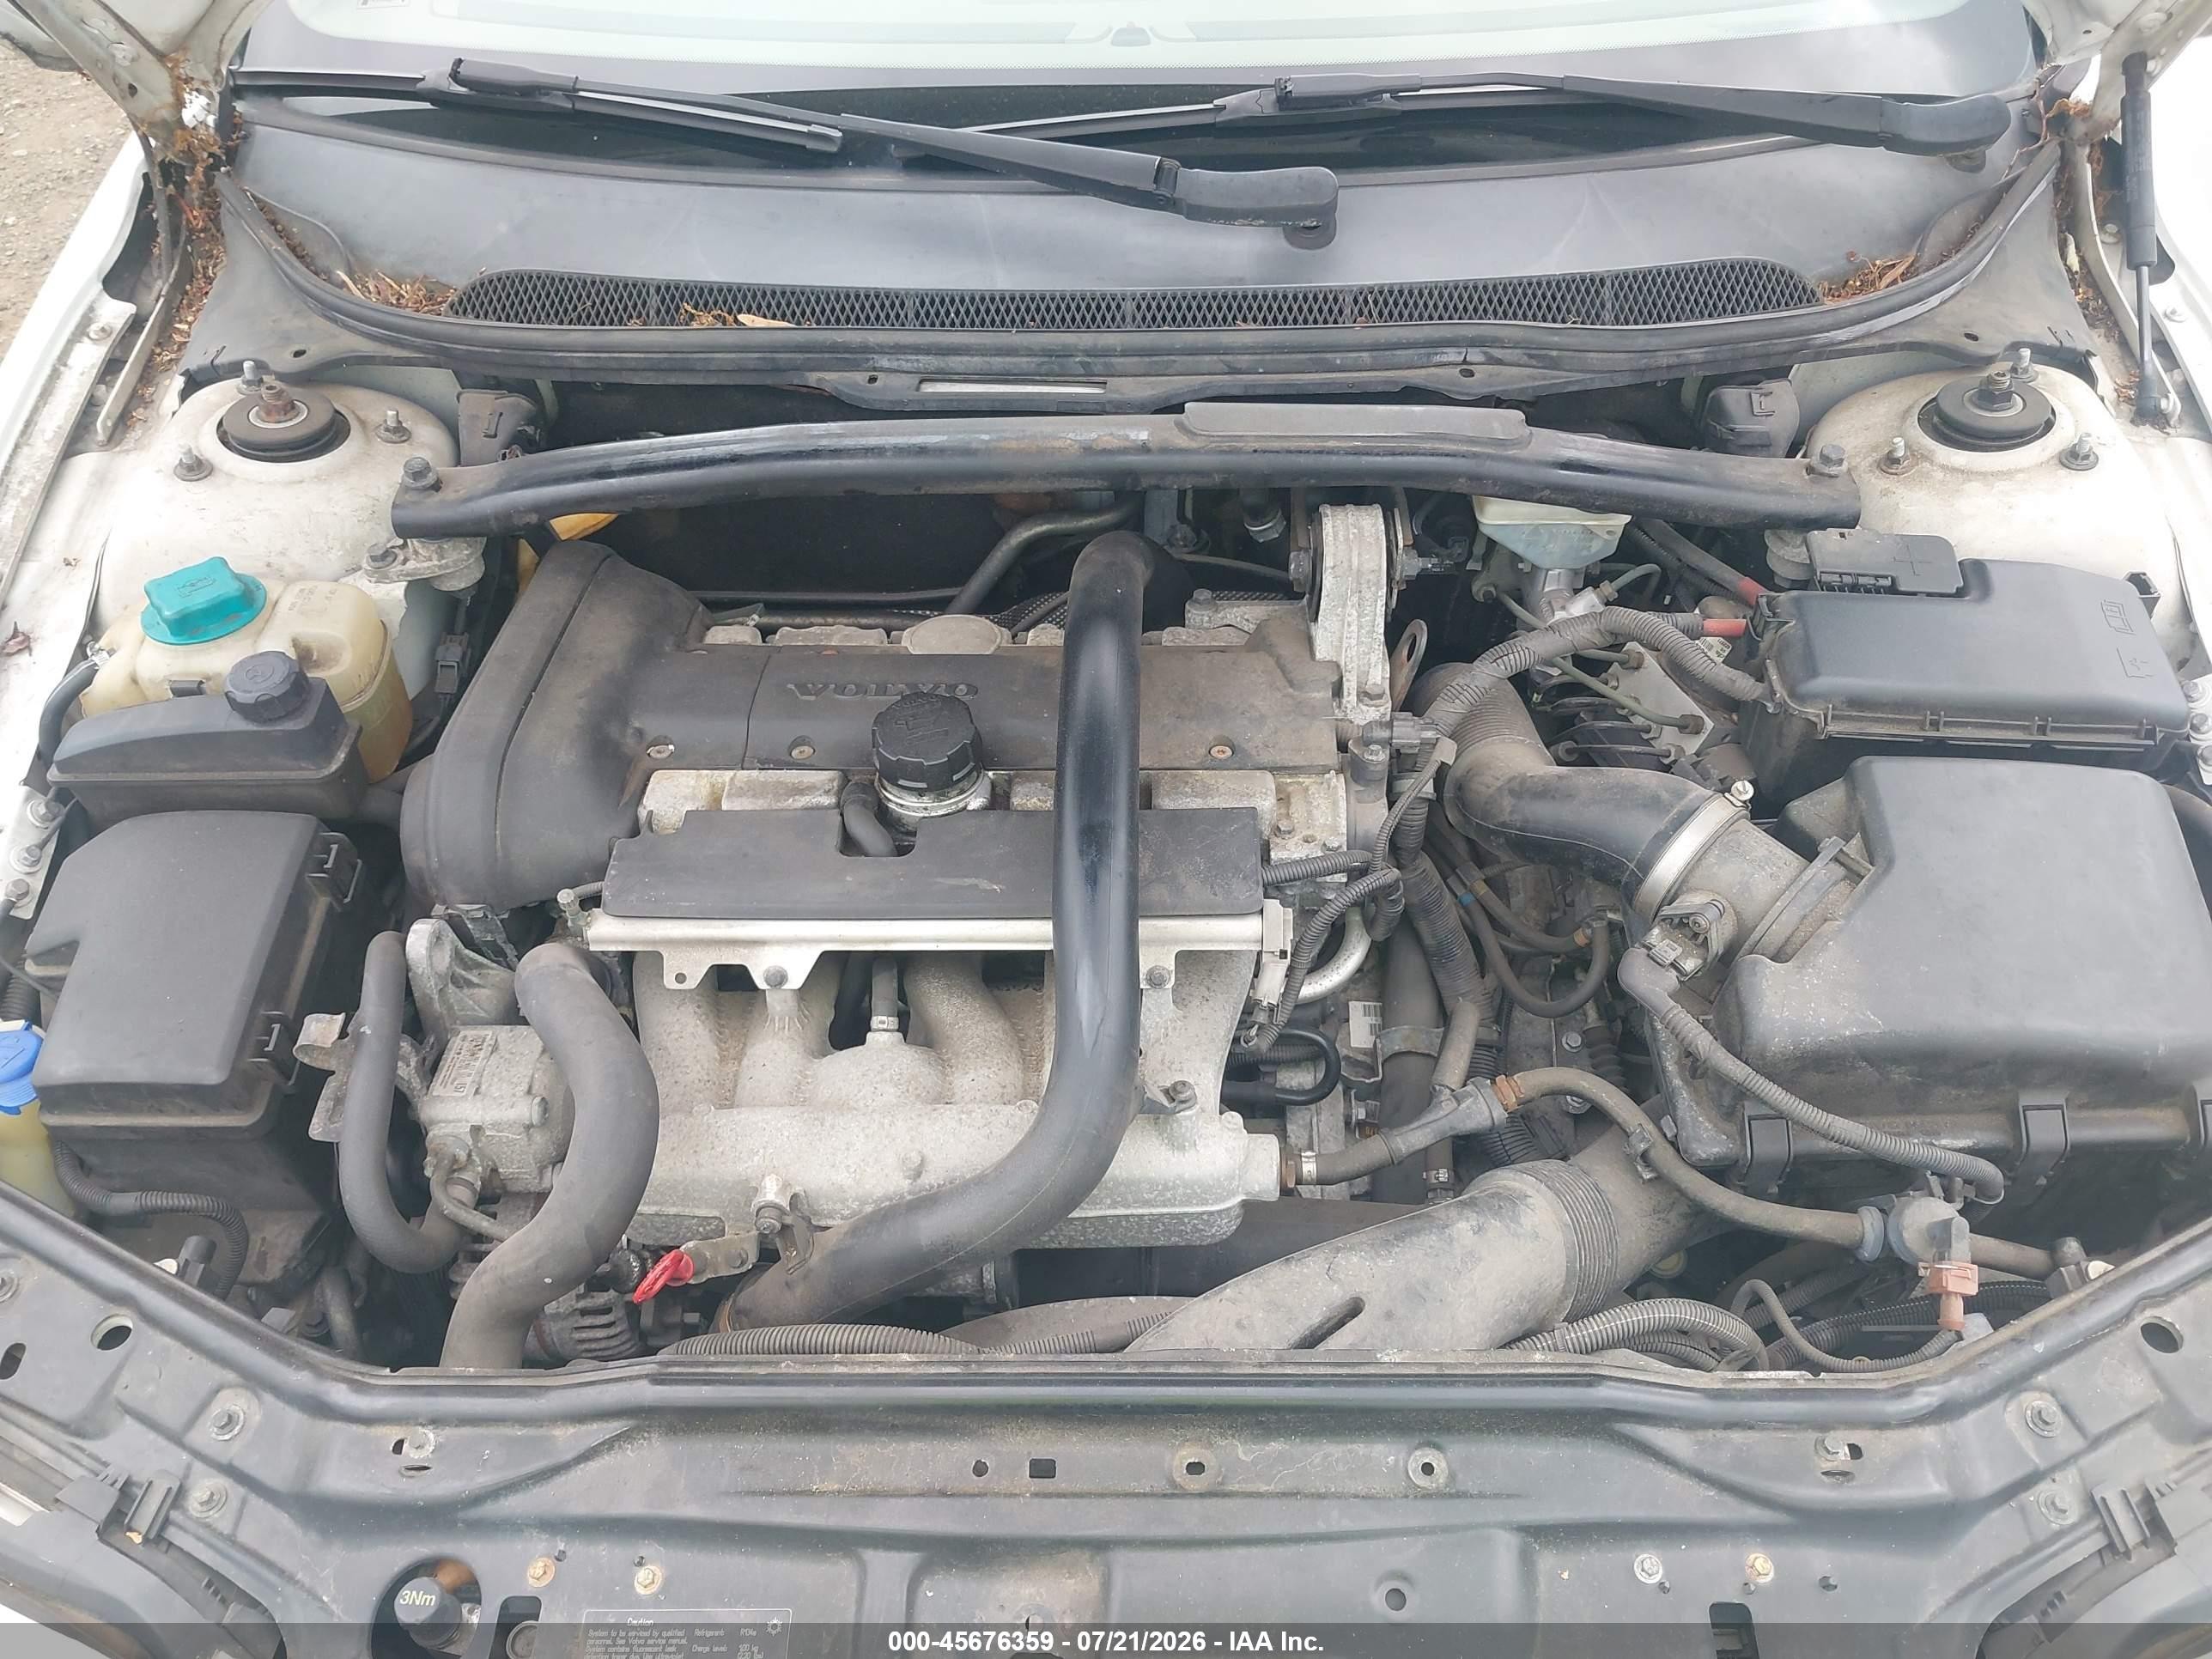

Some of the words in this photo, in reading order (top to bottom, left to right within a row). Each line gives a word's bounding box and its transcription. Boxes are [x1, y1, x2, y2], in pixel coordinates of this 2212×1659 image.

[787, 683, 978, 702] VOLVO
[399, 1590, 436, 1606] 3Nm
[627, 1617, 653, 1626] Caution
[588, 1629, 609, 1638] System
[653, 1629, 659, 1638] by
[661, 1628, 686, 1638] qualified
